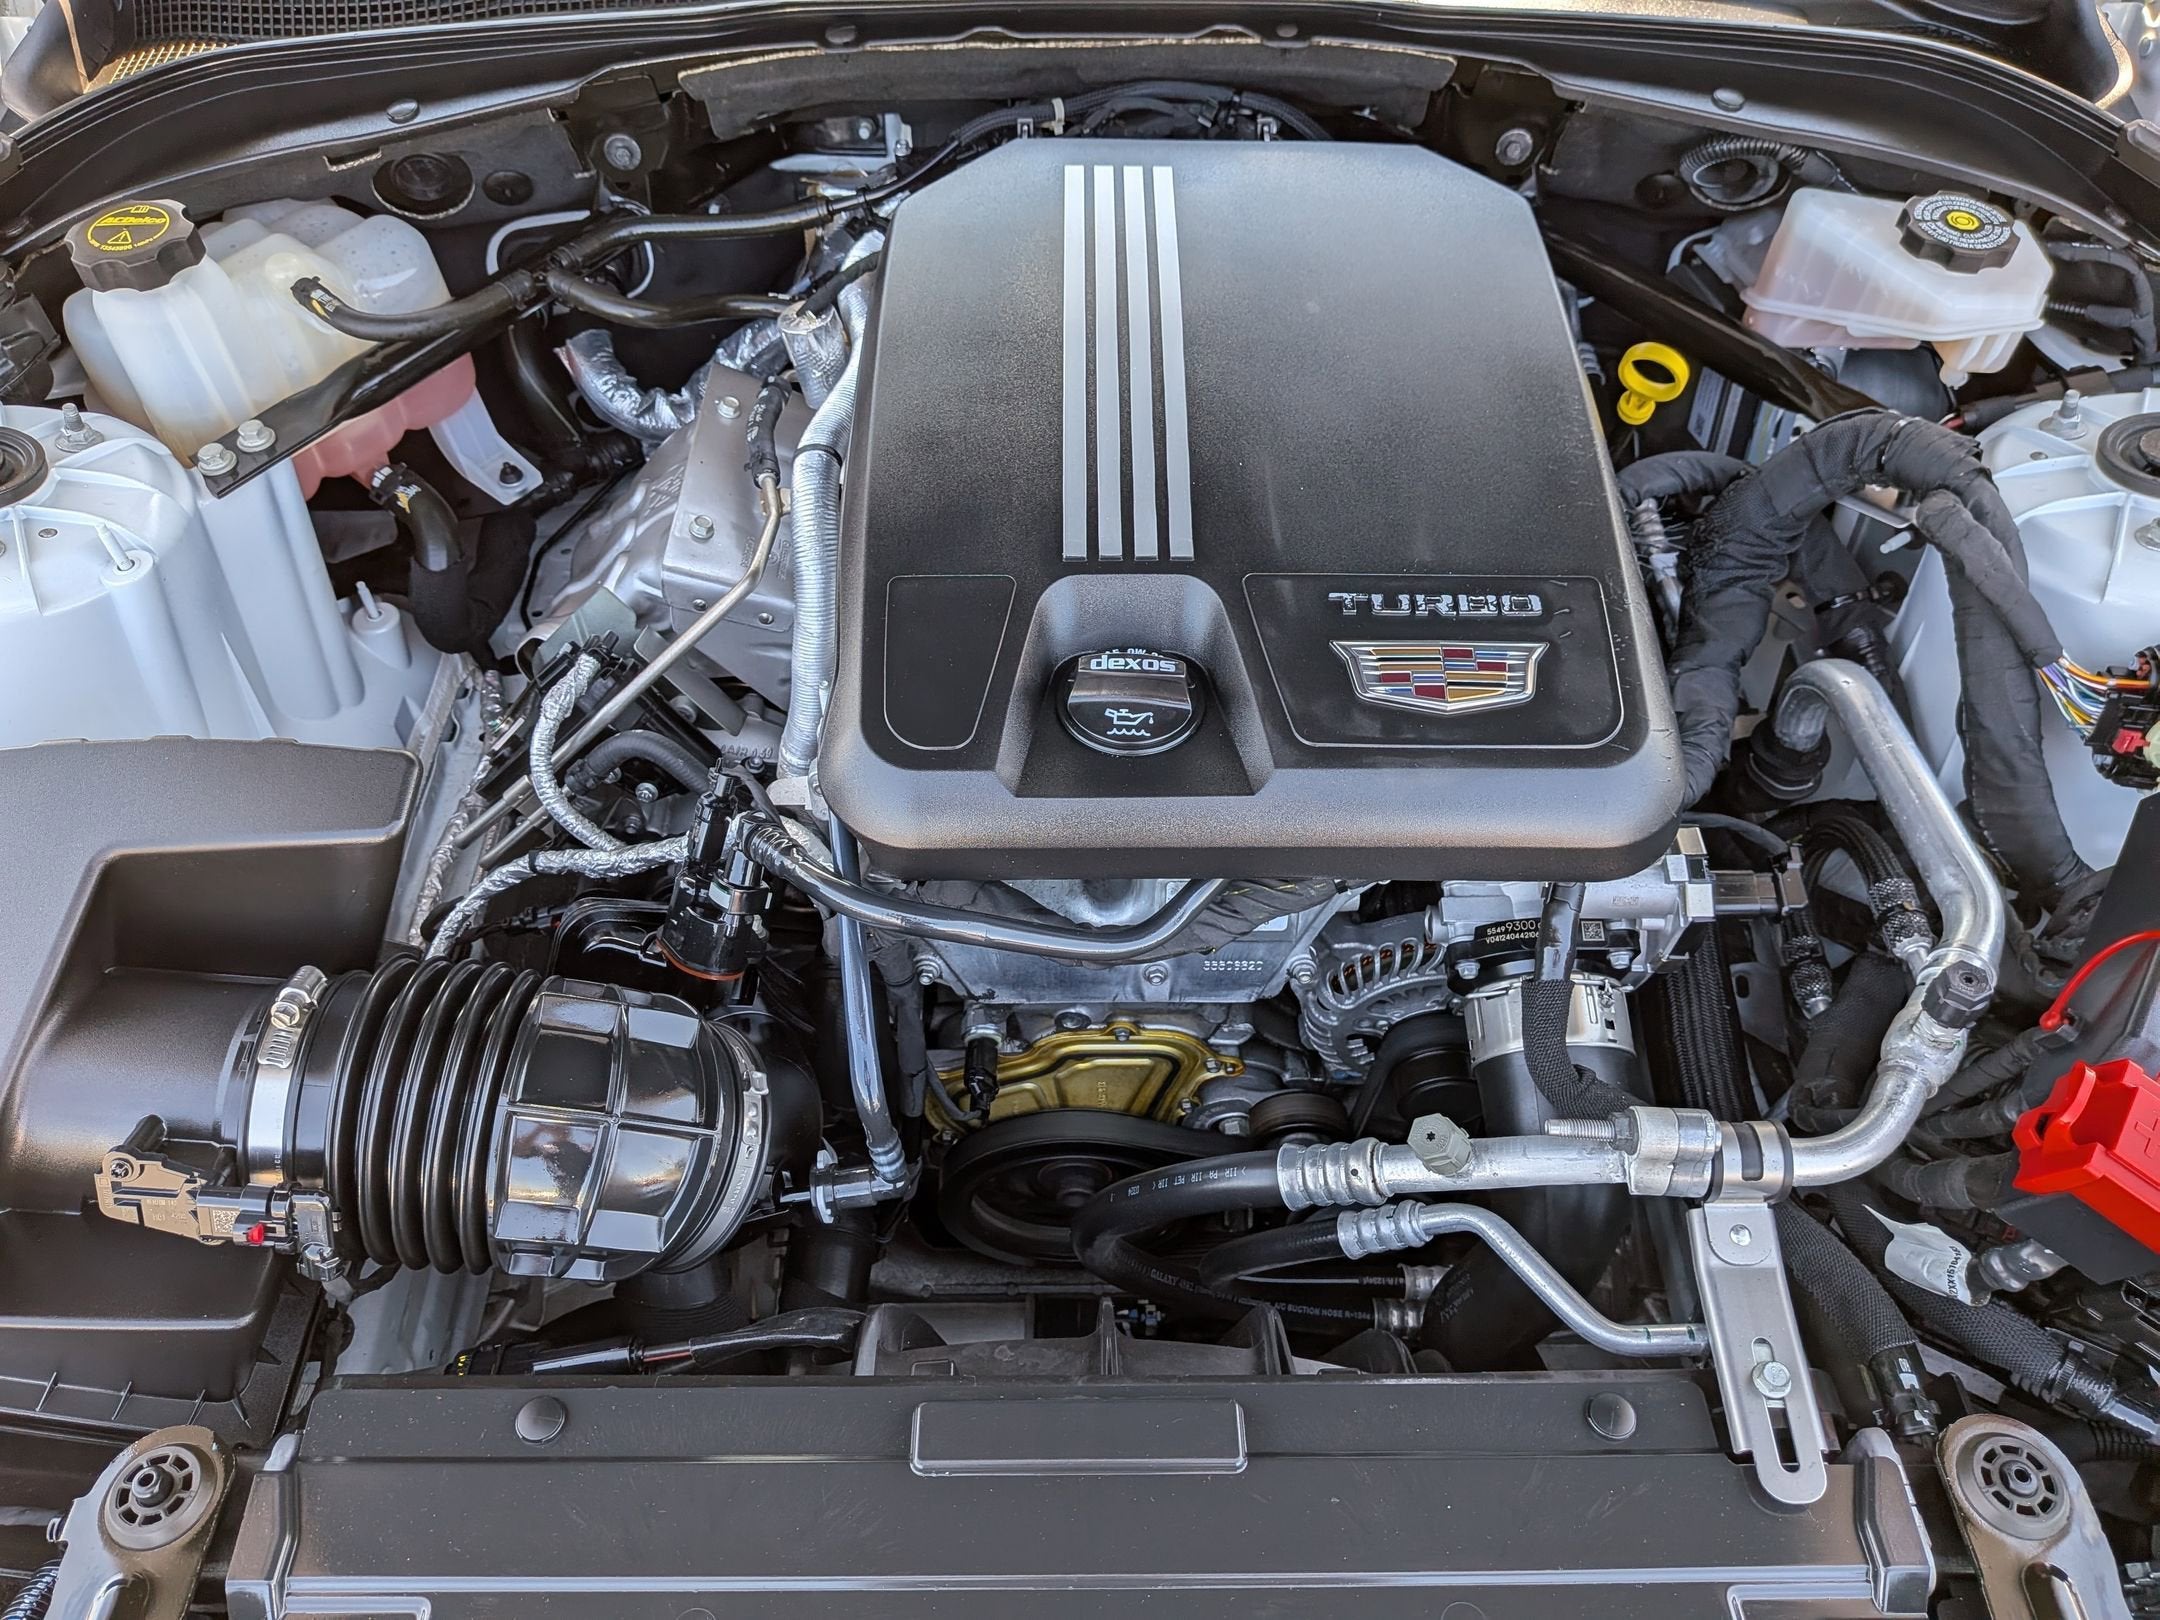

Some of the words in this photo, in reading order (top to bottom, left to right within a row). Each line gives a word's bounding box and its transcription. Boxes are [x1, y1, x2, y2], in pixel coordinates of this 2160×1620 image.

[100, 216, 167, 224] ACDelco
[1328, 592, 1543, 616] TURBO
[1090, 654, 1176, 673] dexos
[1287, 1303, 1321, 1316] SUCTION
[1321, 1307, 1343, 1318] HOSE
